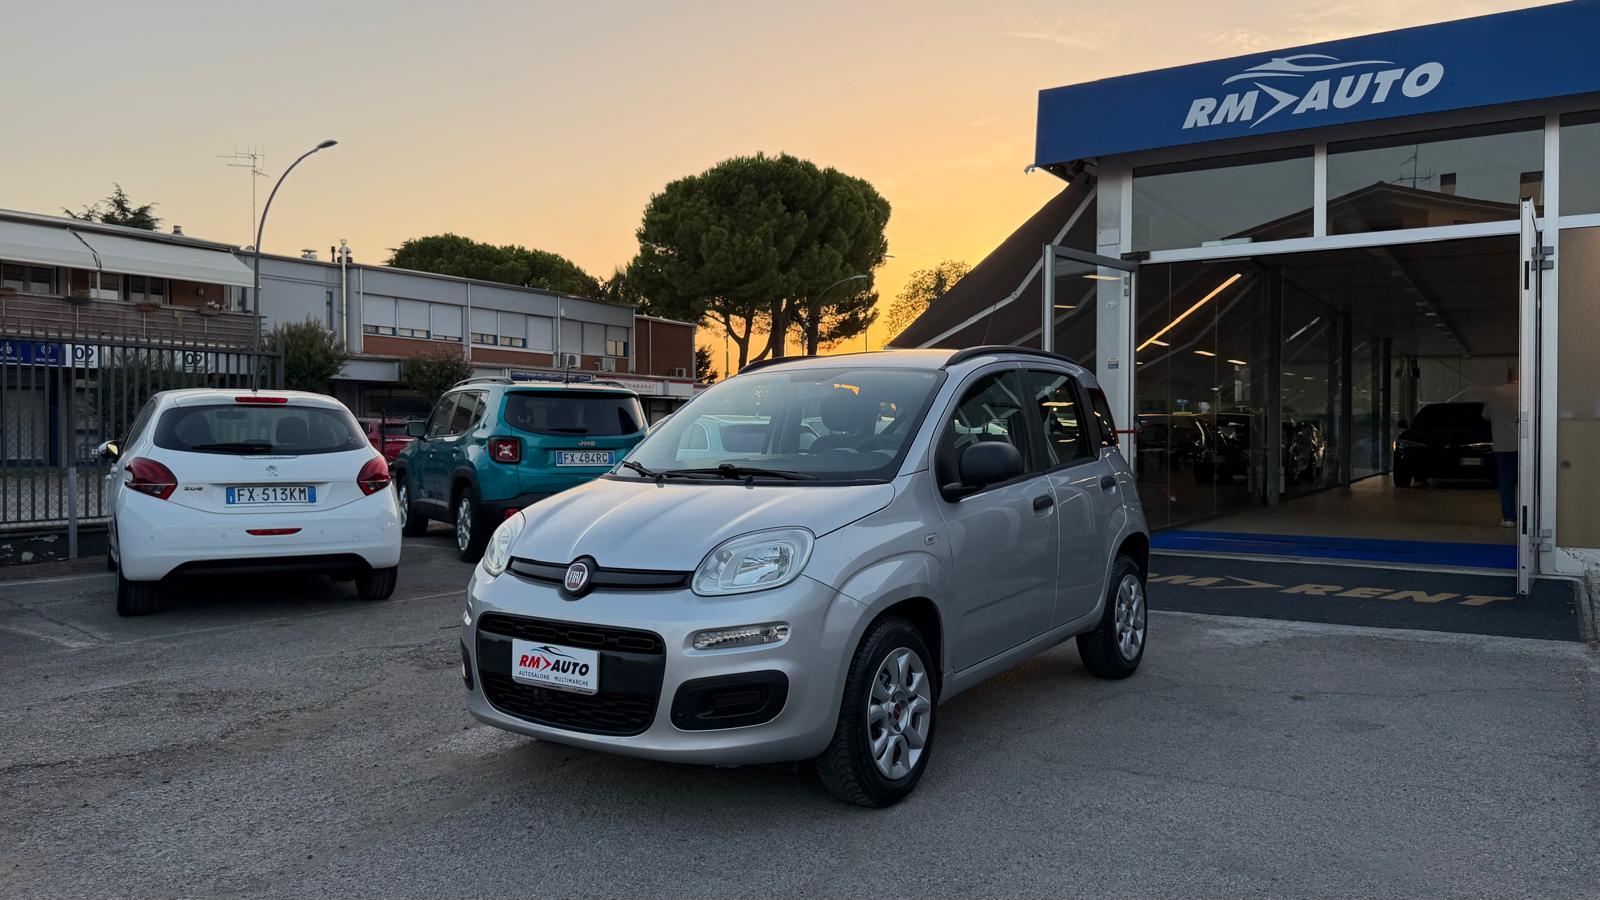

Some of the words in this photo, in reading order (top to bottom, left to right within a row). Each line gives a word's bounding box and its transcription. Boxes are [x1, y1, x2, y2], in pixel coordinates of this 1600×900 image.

[1291, 61, 1445, 115] AUTO
[568, 570, 584, 584] FIAT
[1278, 582, 1516, 607] RENT
[550, 659, 590, 677] AUTO
[518, 670, 550, 681] AUTOSALONE
[554, 676, 589, 687] MULTIMARCHE
